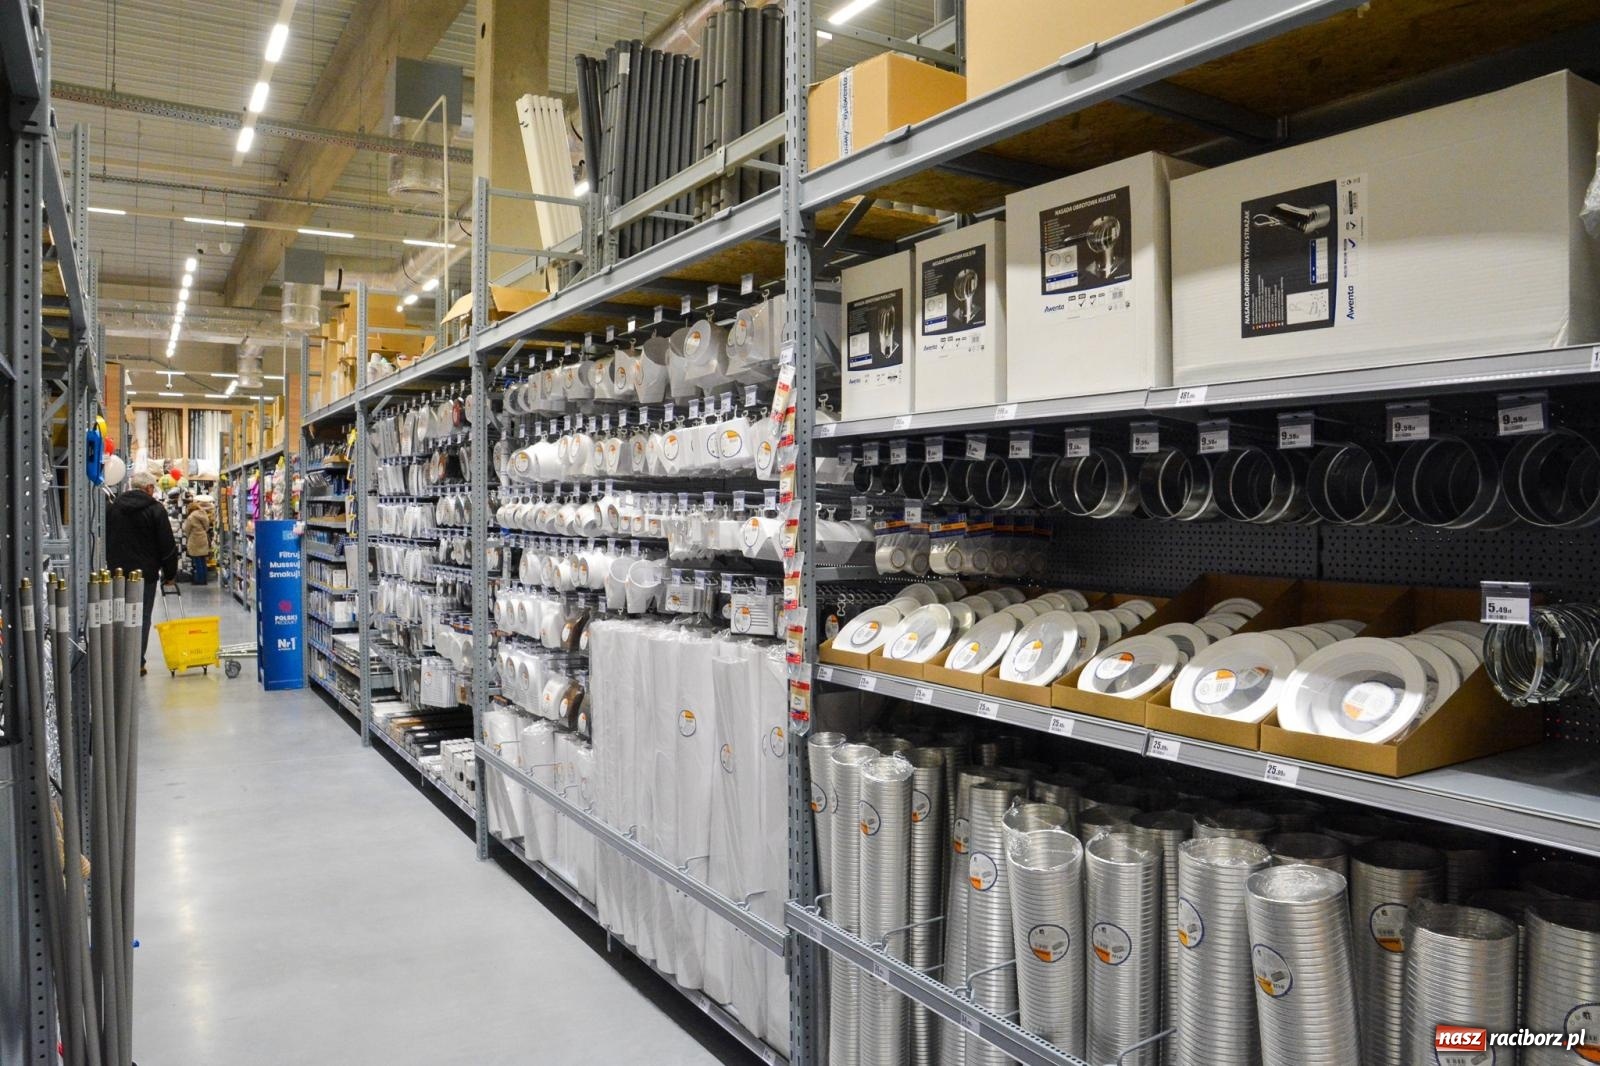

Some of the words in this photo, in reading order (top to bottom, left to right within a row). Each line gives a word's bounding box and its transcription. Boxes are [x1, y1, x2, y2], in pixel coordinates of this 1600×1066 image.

[1346, 285, 1355, 320] Awenta
[1044, 303, 1065, 314] Awenta
[279, 551, 300, 560] Filtruj
